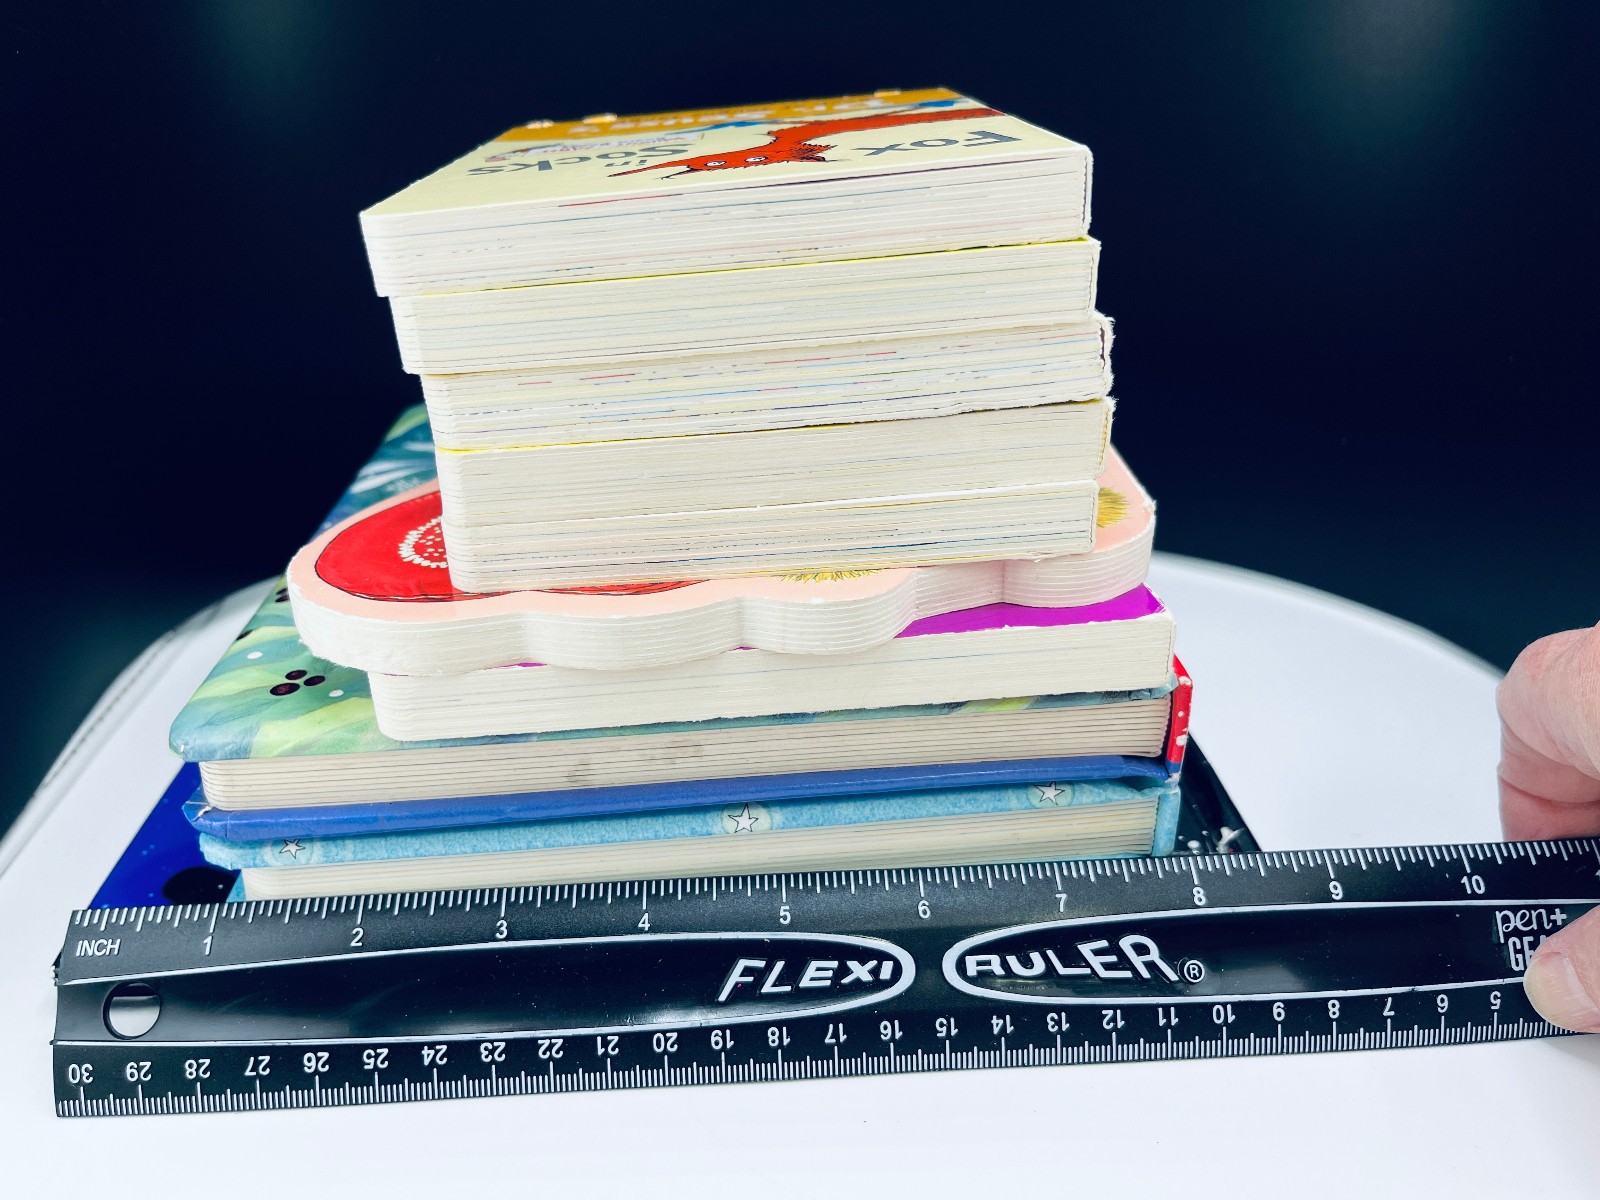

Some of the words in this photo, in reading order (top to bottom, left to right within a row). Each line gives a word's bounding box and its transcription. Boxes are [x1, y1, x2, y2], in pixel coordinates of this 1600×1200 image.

[850, 130, 1022, 157] Fox
[467, 143, 695, 176] Socks
[604, 159, 648, 168] in
[76, 938, 120, 957] INCH
[203, 935, 213, 955] 1
[350, 928, 364, 947] 2
[495, 920, 509, 939] 3
[638, 912, 651, 931] 4
[780, 905, 792, 925] 5
[918, 900, 931, 919] 6
[1055, 893, 1068, 913] 7
[1193, 886, 1207, 906] 8
[1329, 881, 1344, 901] 9
[1461, 874, 1485, 895] 10
[1495, 908, 1567, 944] pen+
[1508, 935, 1547, 971] GE
[717, 959, 893, 1002] FLEXI
[965, 934, 1179, 983] RULER
[1328, 999, 1340, 1018] 8
[1383, 997, 1394, 1016] 7
[1437, 994, 1448, 1013] 6
[1490, 991, 1501, 1009] 5
[1102, 1010, 1124, 1029] 12
[1158, 1007, 1178, 1027] 11
[1212, 1003, 1235, 1024] 10
[1273, 1001, 1285, 1021] 9
[880, 1020, 902, 1040] 16
[936, 1015, 958, 1036] 15
[991, 1015, 1014, 1034] 14
[1047, 1012, 1069, 1032] 13
[652, 1032, 678, 1052] 20
[711, 1029, 734, 1049] 19
[768, 1027, 790, 1046] 18
[825, 1023, 847, 1043] 17
[422, 1045, 447, 1065] 24
[480, 1042, 505, 1062] 23
[538, 1038, 563, 1058] 22
[596, 1035, 619, 1055] 21
[245, 1056, 270, 1076] 27
[304, 1052, 329, 1073] 26
[363, 1048, 388, 1069] 25
[68, 1064, 93, 1084] 30
[126, 1062, 151, 1081] 29
[185, 1059, 210, 1079] 28
